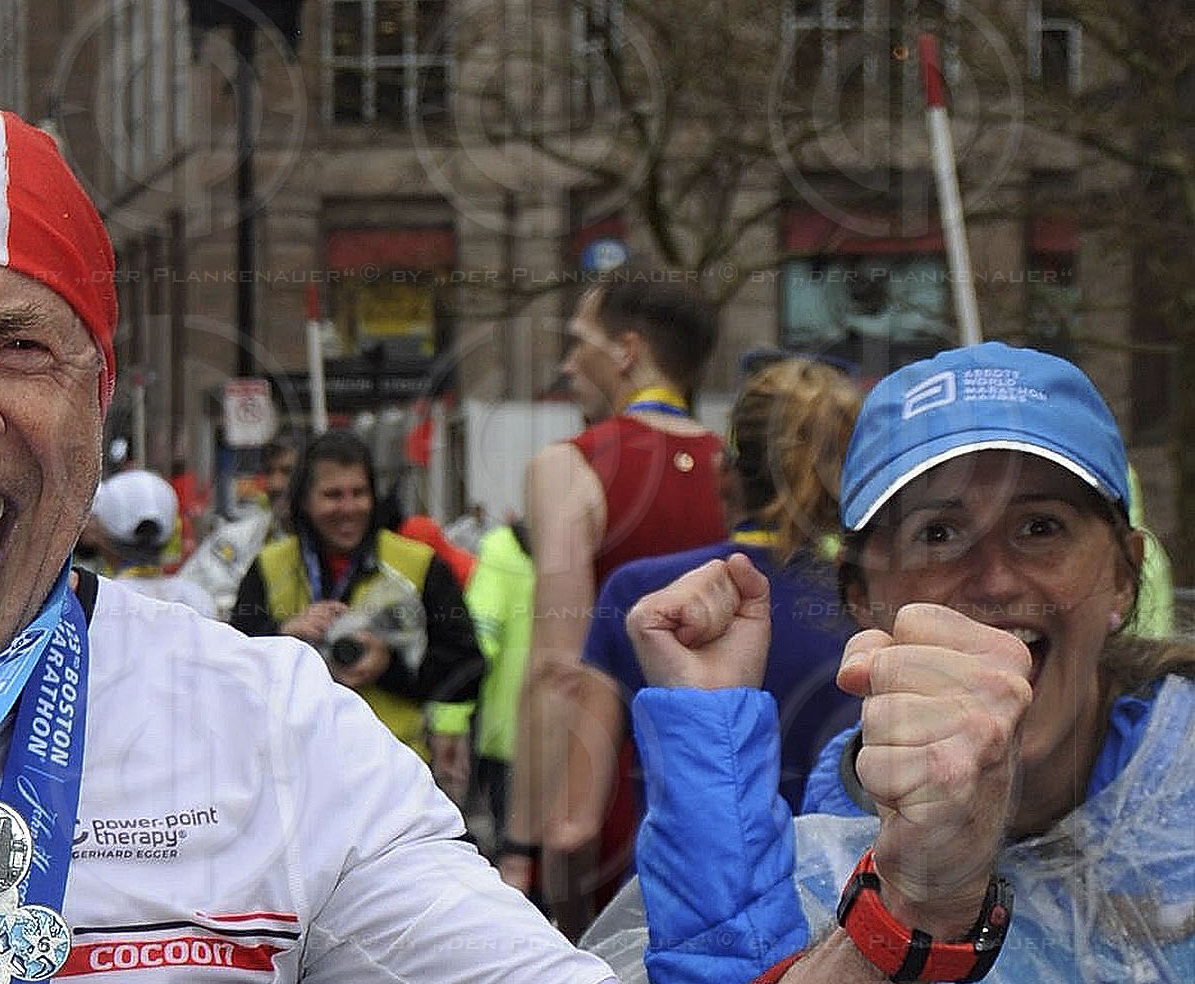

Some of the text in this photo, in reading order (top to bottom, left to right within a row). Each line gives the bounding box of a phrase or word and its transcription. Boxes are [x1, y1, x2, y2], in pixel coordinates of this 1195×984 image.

[49, 666, 79, 767] BOSTON
[91, 806, 219, 830] power-point
[136, 849, 179, 859] EGGER
